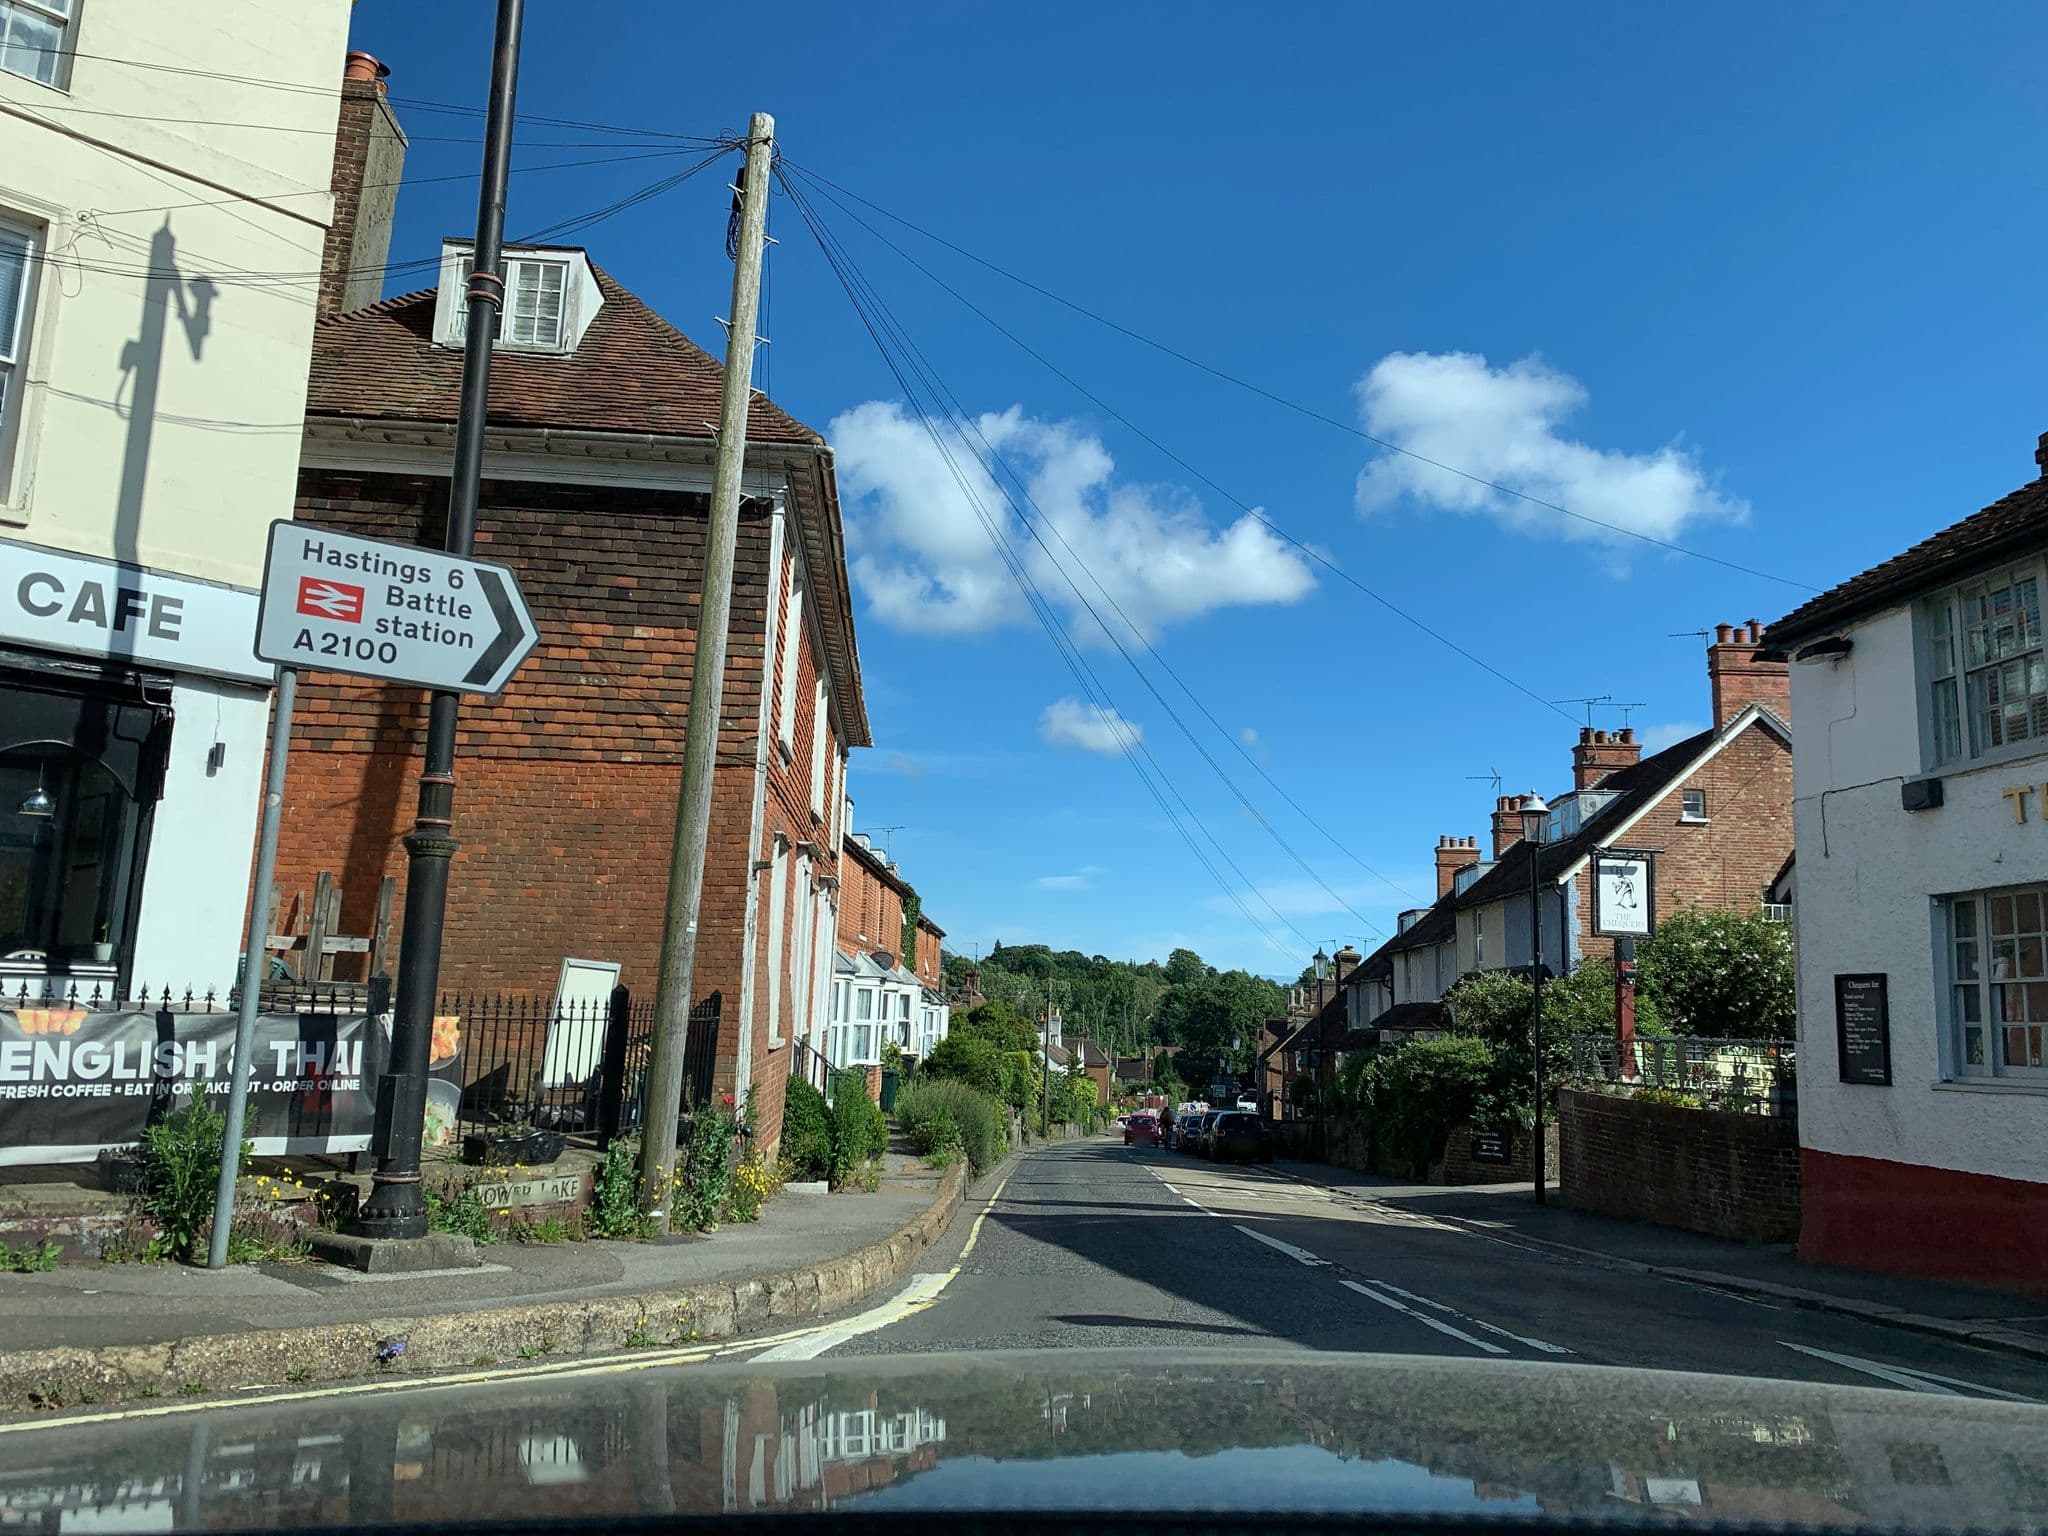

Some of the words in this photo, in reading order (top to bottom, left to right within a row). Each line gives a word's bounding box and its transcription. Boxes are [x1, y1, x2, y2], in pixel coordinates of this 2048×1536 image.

[302, 539, 431, 584] Hastings
[447, 569, 464, 590] 6
[17, 572, 184, 641] CAFE
[386, 584, 472, 620] Battle
[293, 628, 397, 664] A2100
[374, 615, 473, 649] station
[0, 1040, 217, 1081] ENGLISH
[269, 1040, 363, 1077] THAI
[0, 1084, 49, 1099] FRESH
[51, 1083, 112, 1097] COFFEE
[124, 1083, 153, 1096] EAT
[156, 1083, 171, 1095] IN
[272, 1080, 314, 1093] ORDER
[317, 1079, 360, 1091] ONLINE
